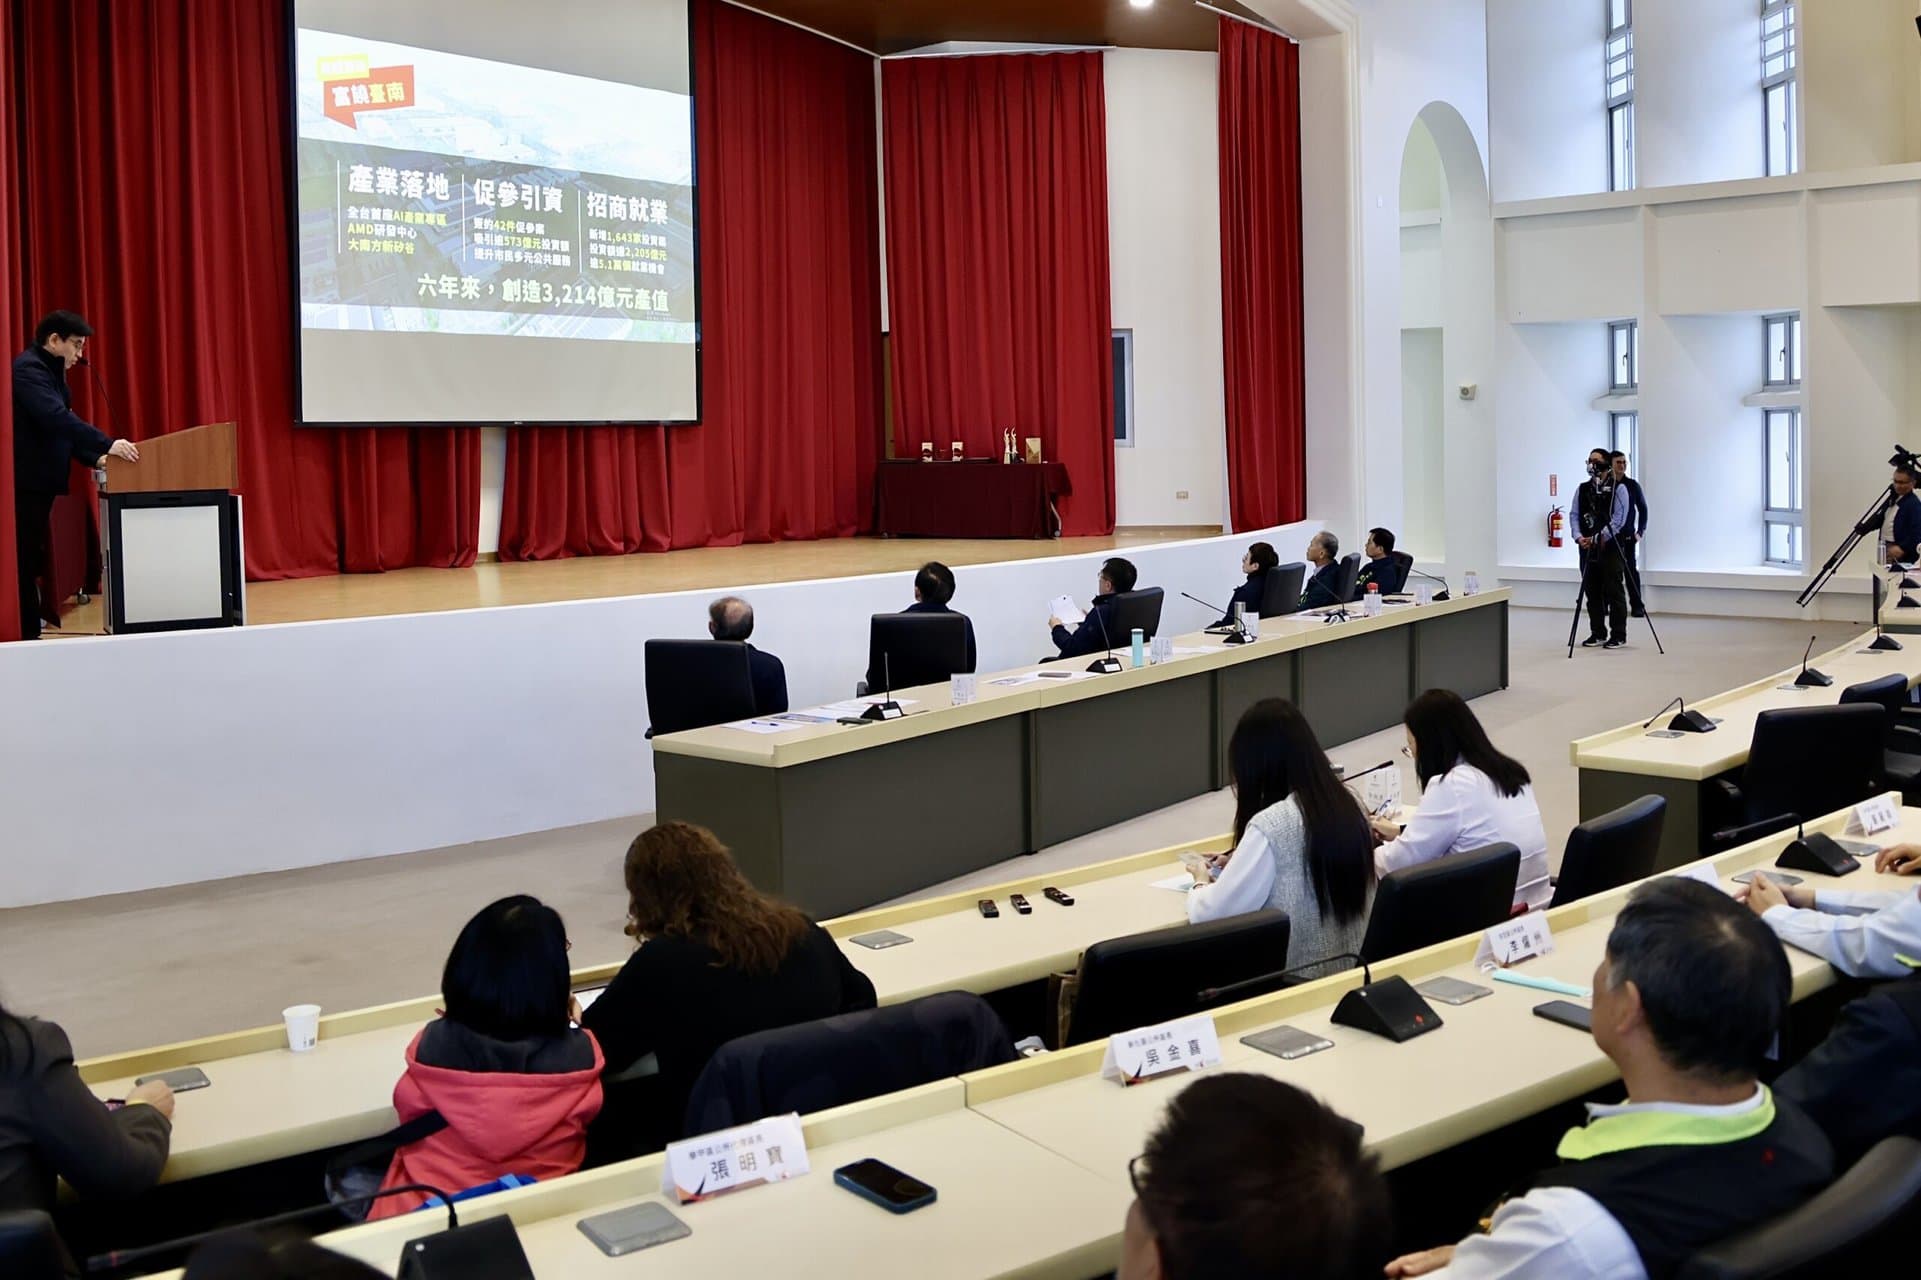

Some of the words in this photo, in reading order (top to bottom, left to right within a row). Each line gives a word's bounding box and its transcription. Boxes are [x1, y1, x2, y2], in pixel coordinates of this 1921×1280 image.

[348, 164, 450, 200] 產業落地
[473, 178, 563, 213] 促參引資
[586, 190, 668, 225] 招商就業
[347, 222, 418, 239] AMD研發中心
